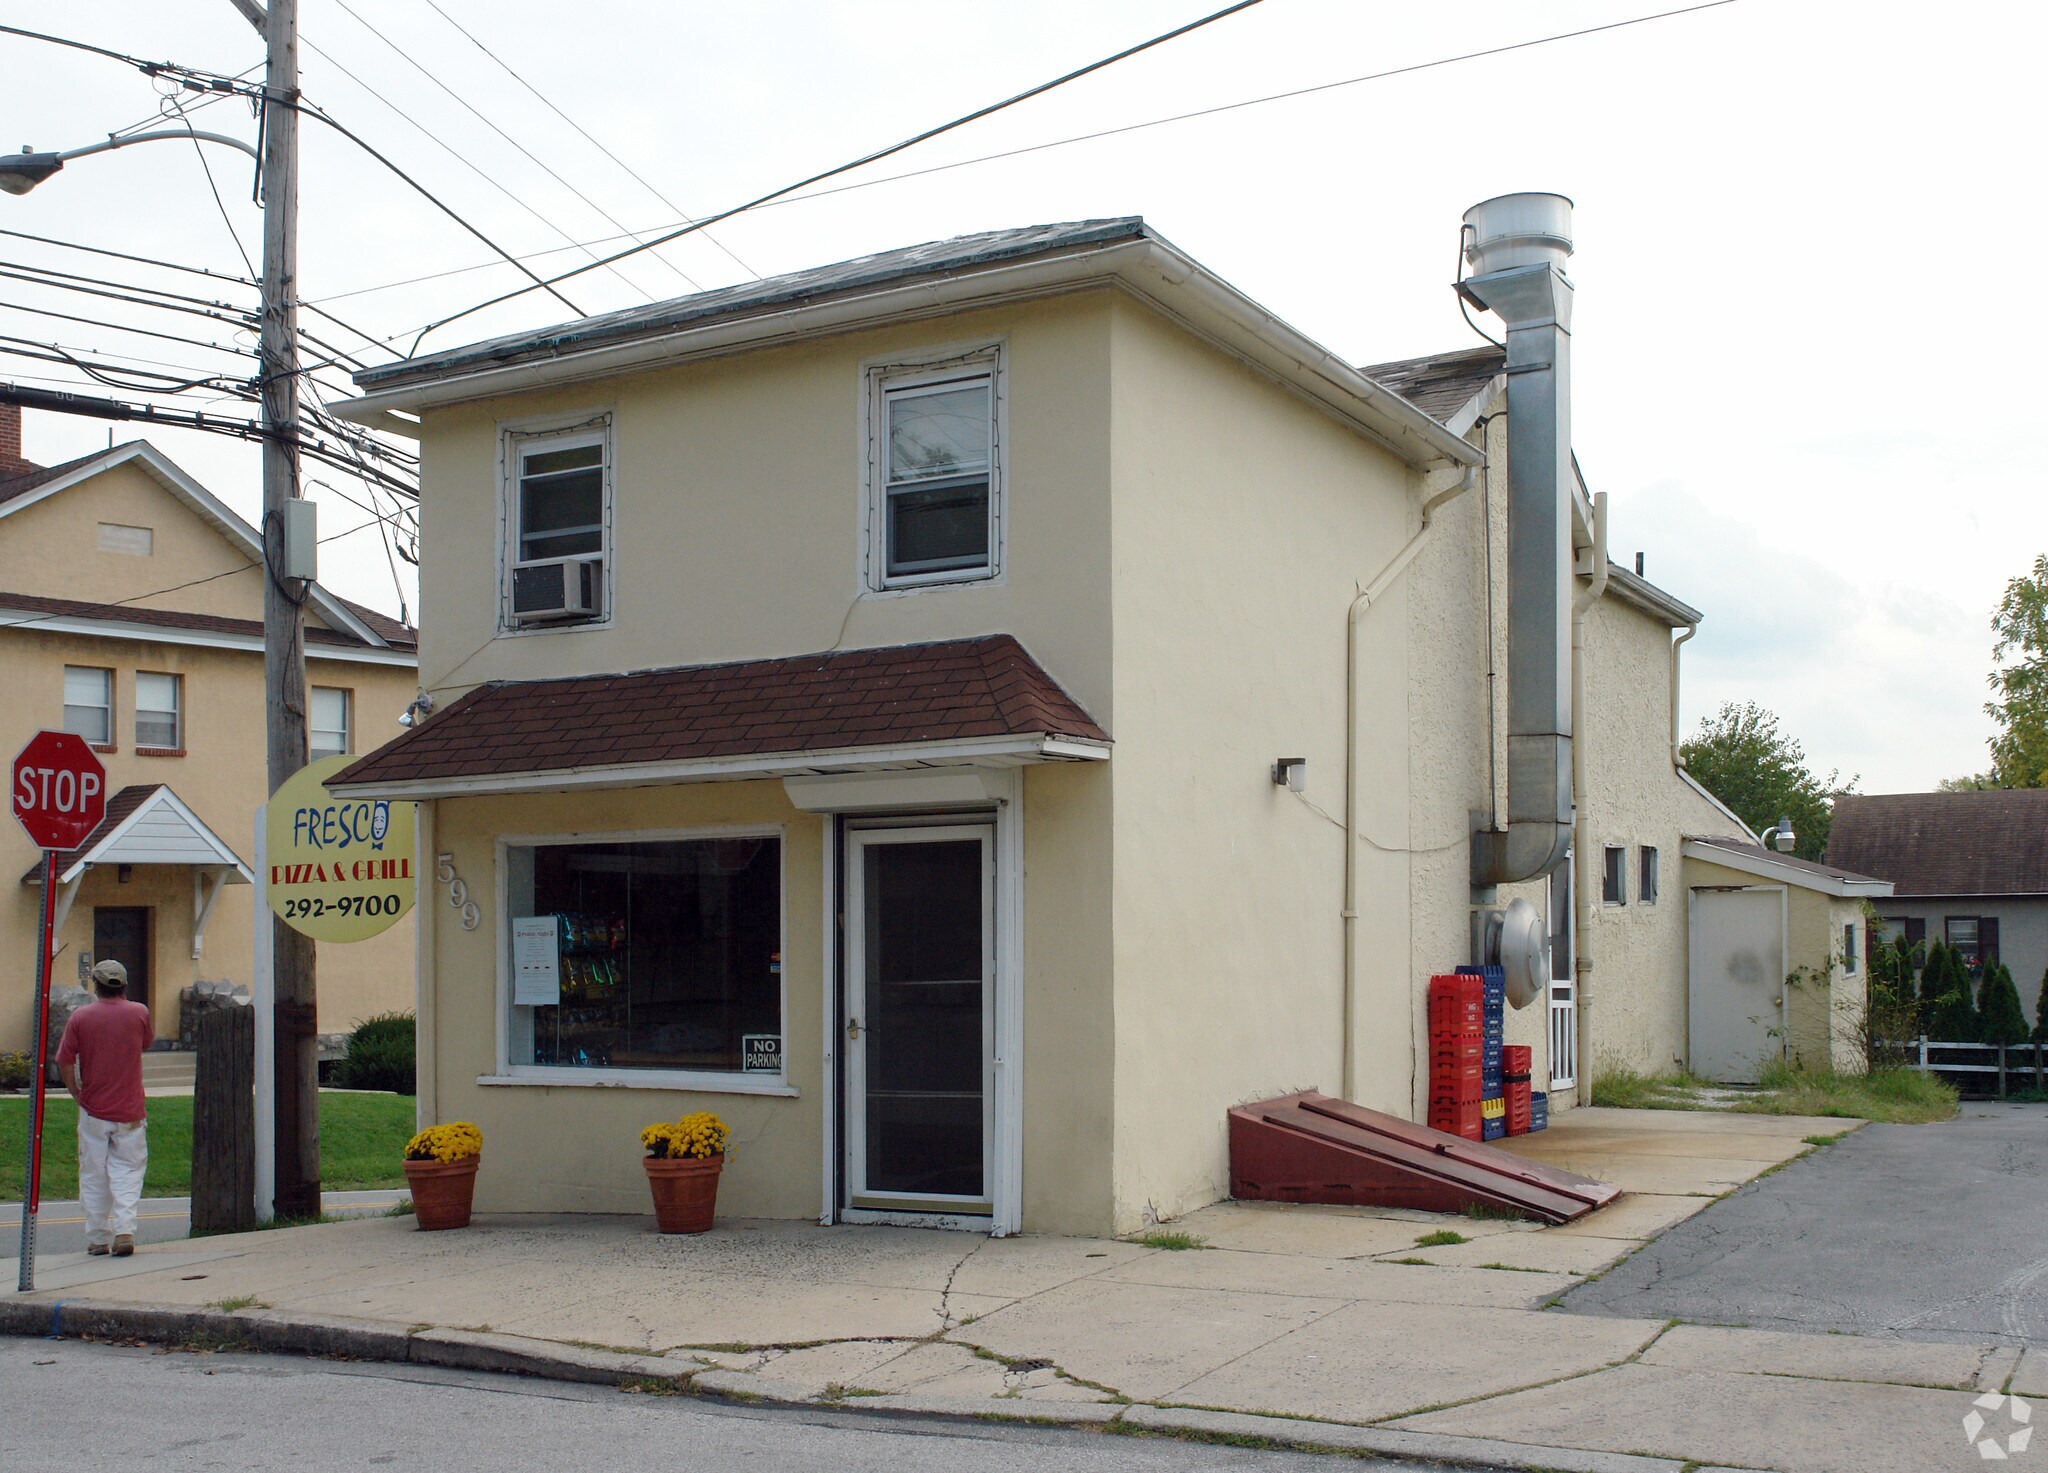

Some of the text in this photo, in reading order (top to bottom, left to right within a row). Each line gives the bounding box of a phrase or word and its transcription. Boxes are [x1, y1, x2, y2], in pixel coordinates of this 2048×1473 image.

[18, 766, 100, 813] STOP
[293, 800, 390, 850] FRESCO
[271, 858, 414, 885] PIZZA & GRILL
[285, 894, 401, 919] 292-9700
[437, 852, 481, 931] 599
[753, 1040, 776, 1052] NO
